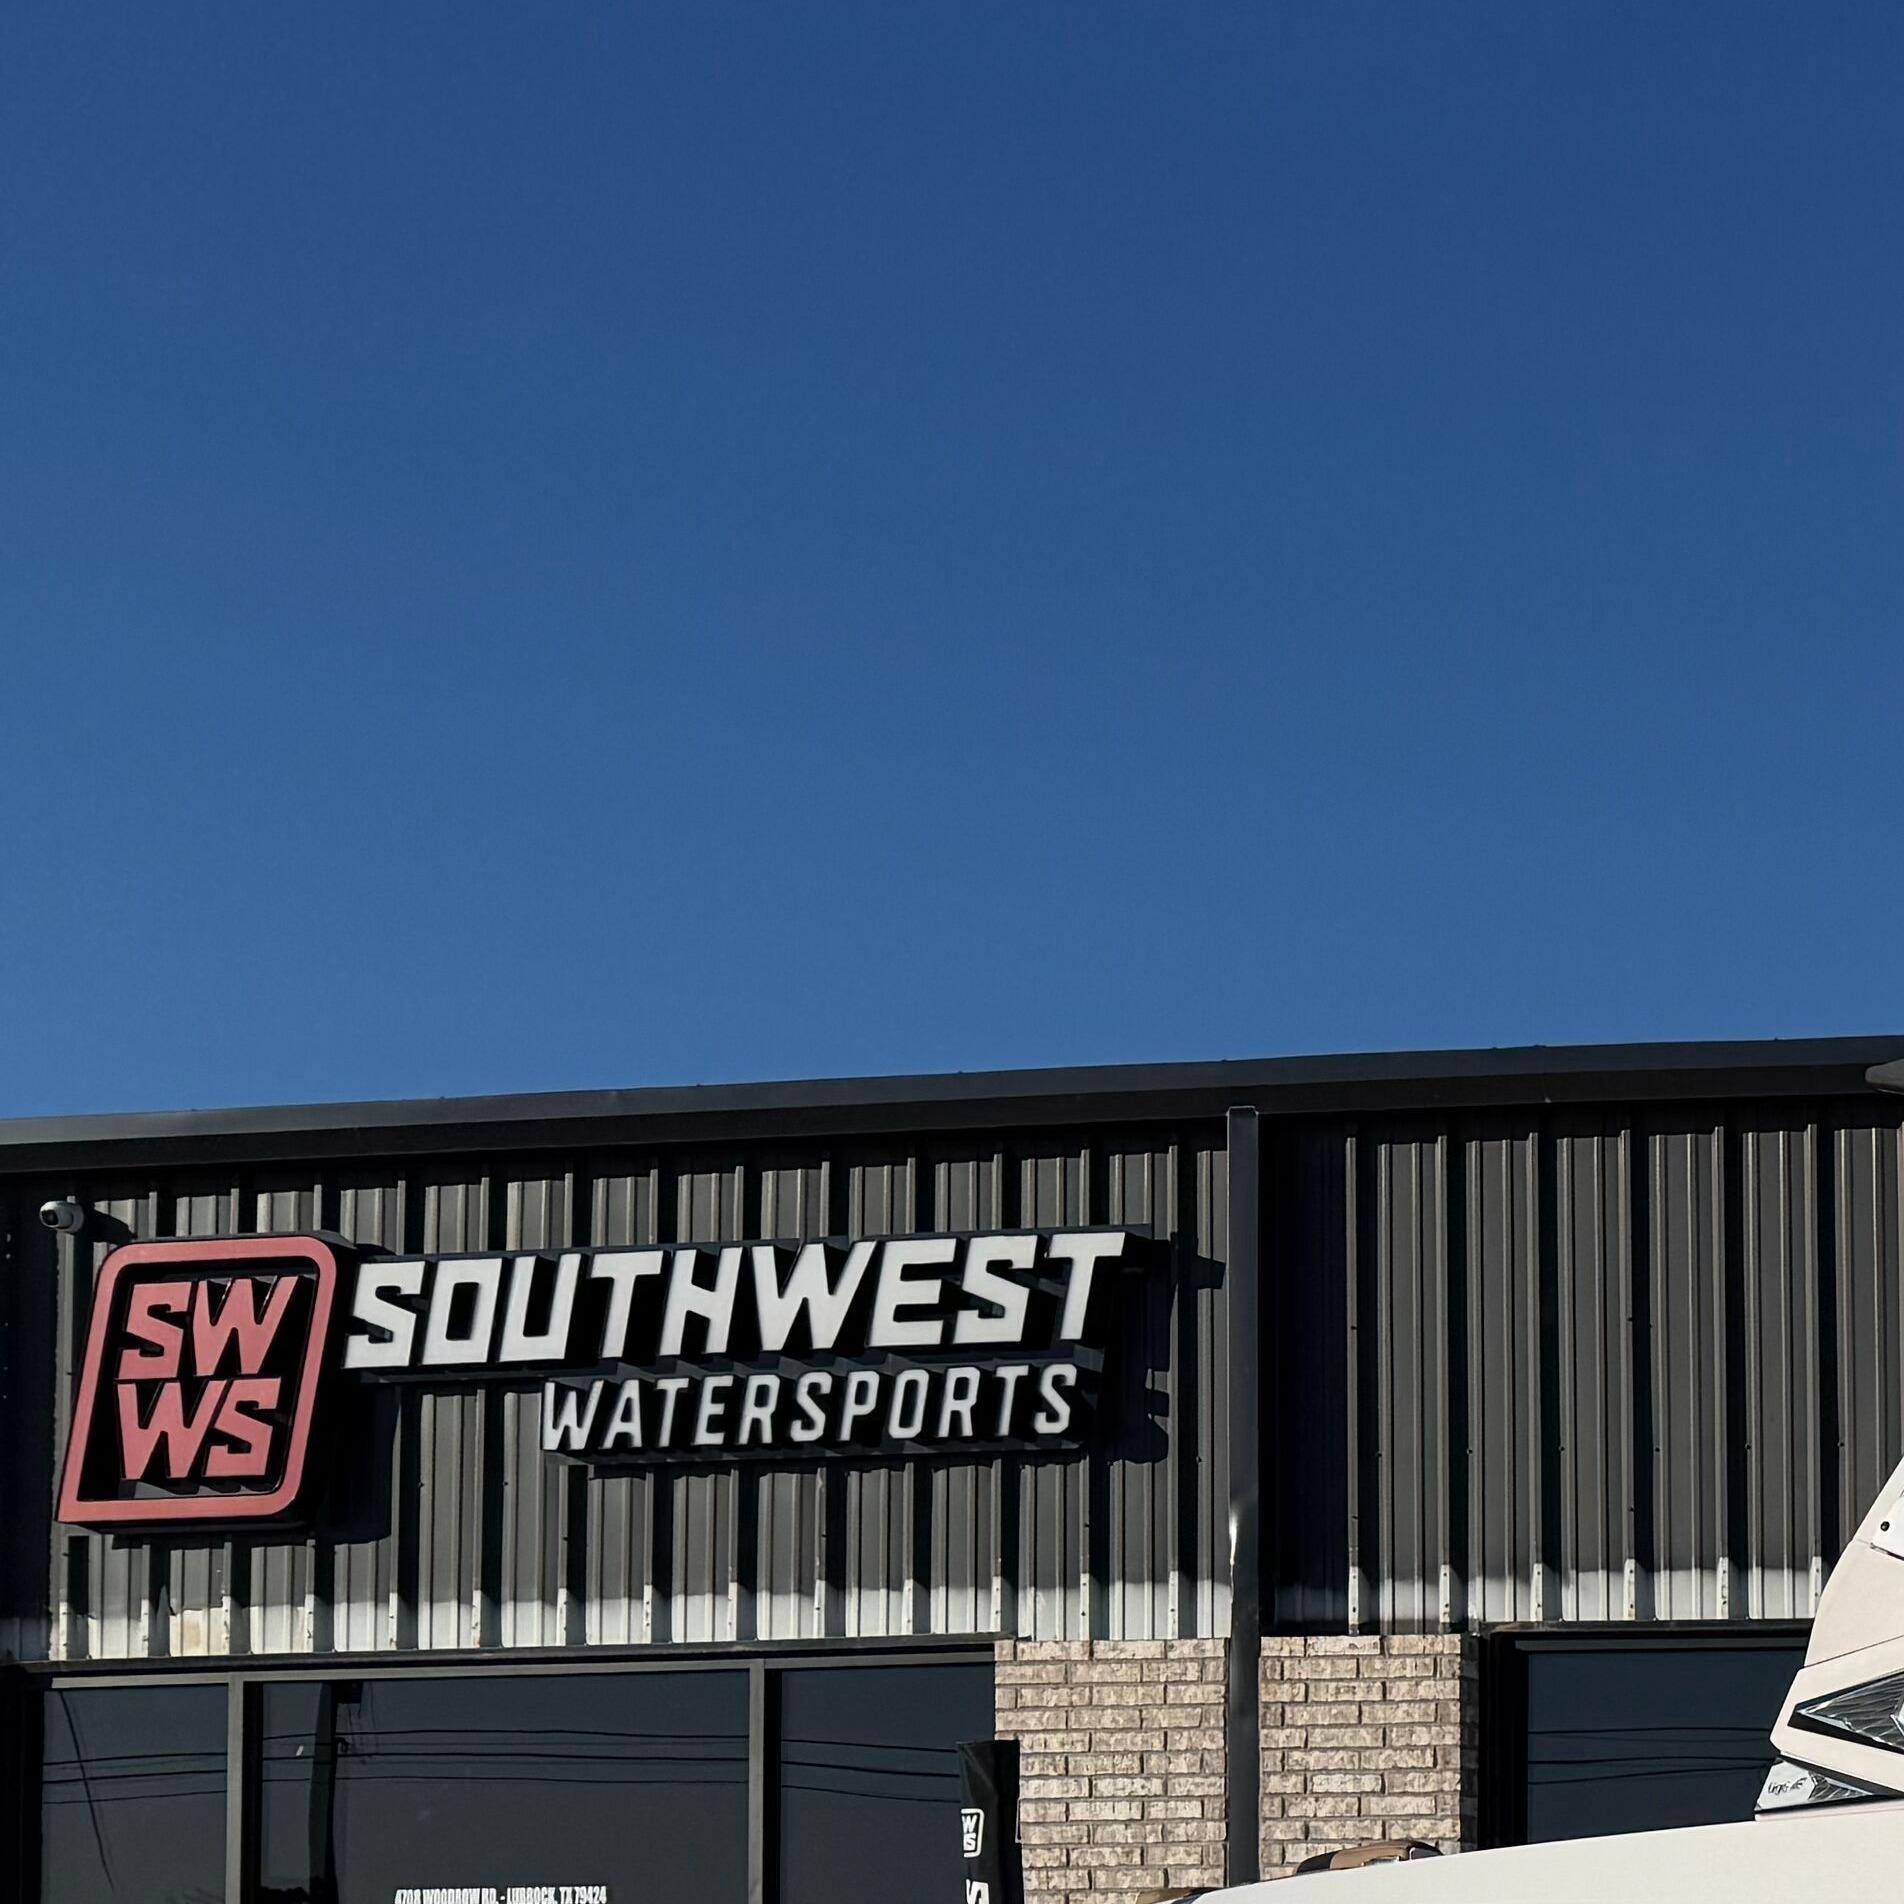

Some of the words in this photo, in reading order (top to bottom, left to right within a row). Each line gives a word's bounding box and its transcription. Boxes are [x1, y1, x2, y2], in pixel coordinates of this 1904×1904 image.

[117, 1275, 299, 1379] SW
[343, 1231, 1126, 1369] SOUTHWEST
[116, 1377, 282, 1481] WS
[541, 1362, 1079, 1452] WATERSPORTS
[574, 1885, 607, 1904] 79424
